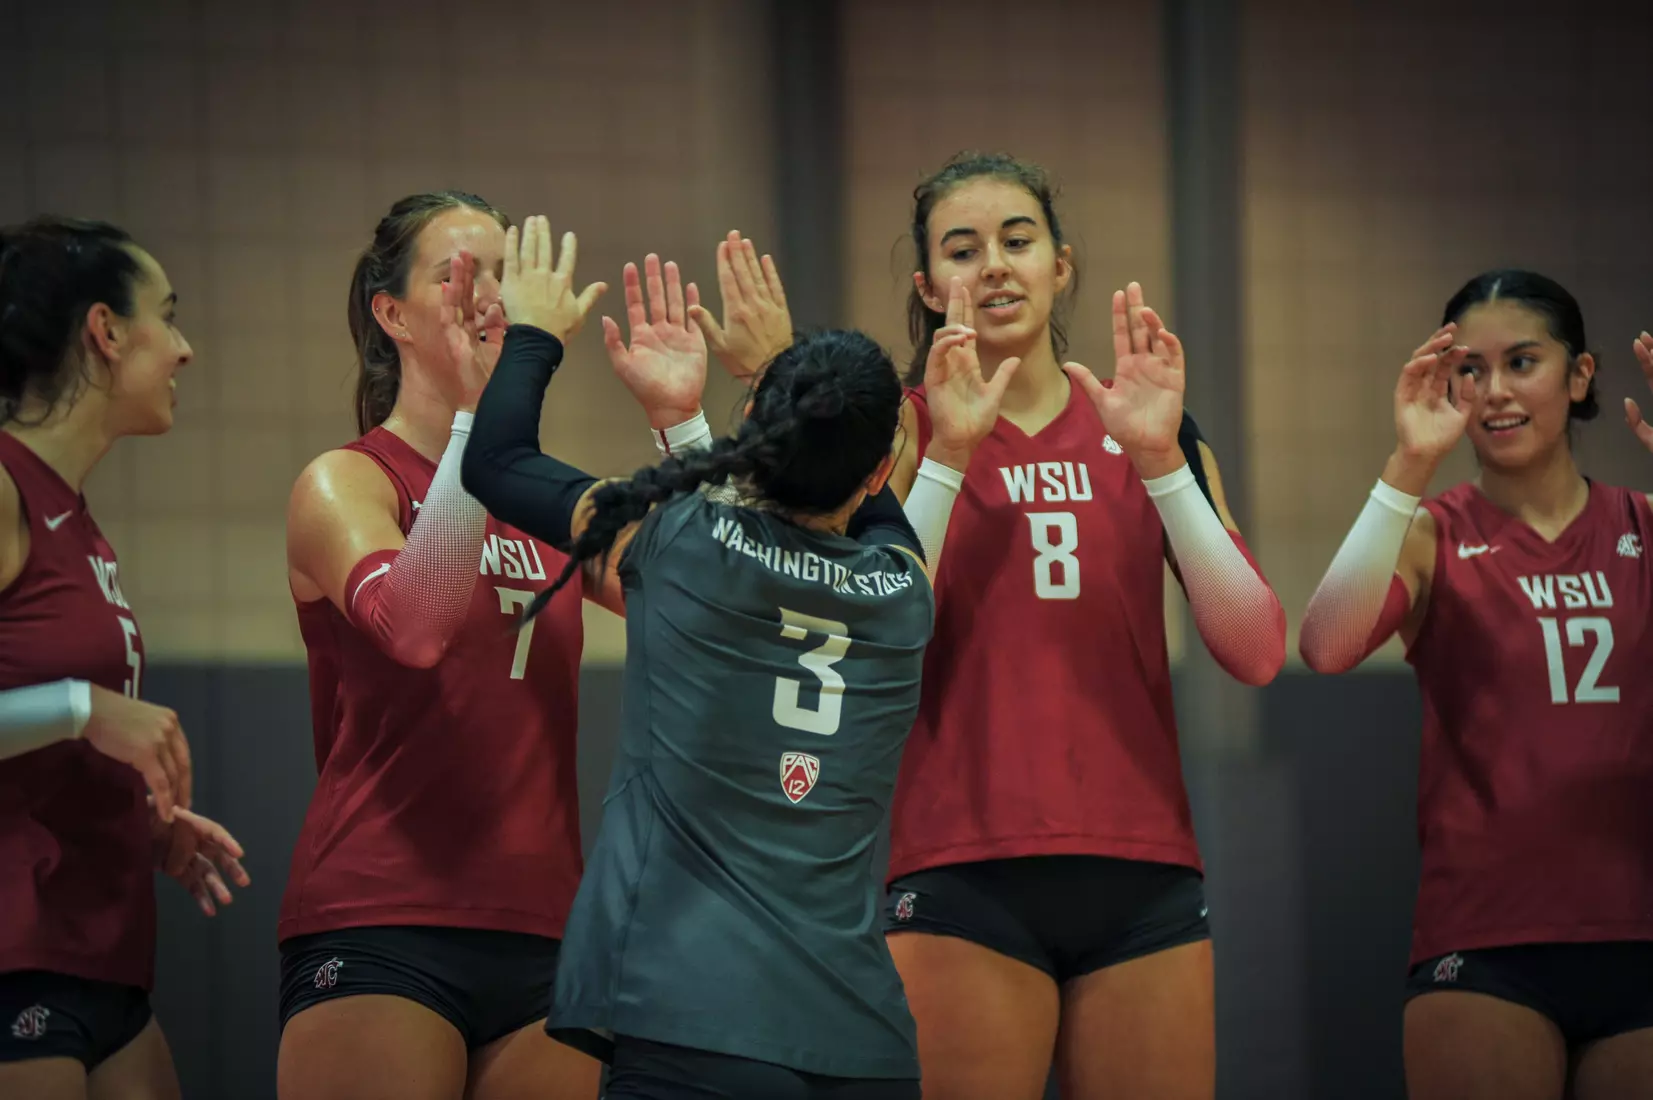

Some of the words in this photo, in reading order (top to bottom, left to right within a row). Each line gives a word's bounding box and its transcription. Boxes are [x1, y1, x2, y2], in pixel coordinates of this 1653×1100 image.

[998, 461, 1093, 503] WSU
[1024, 512, 1081, 600] 8
[1516, 570, 1614, 609] WSU
[116, 615, 141, 700] 5
[493, 586, 536, 680] 7
[772, 606, 852, 736] 3
[1537, 617, 1620, 703] 12
[782, 754, 818, 787] PAC
[788, 779, 805, 795] 12
